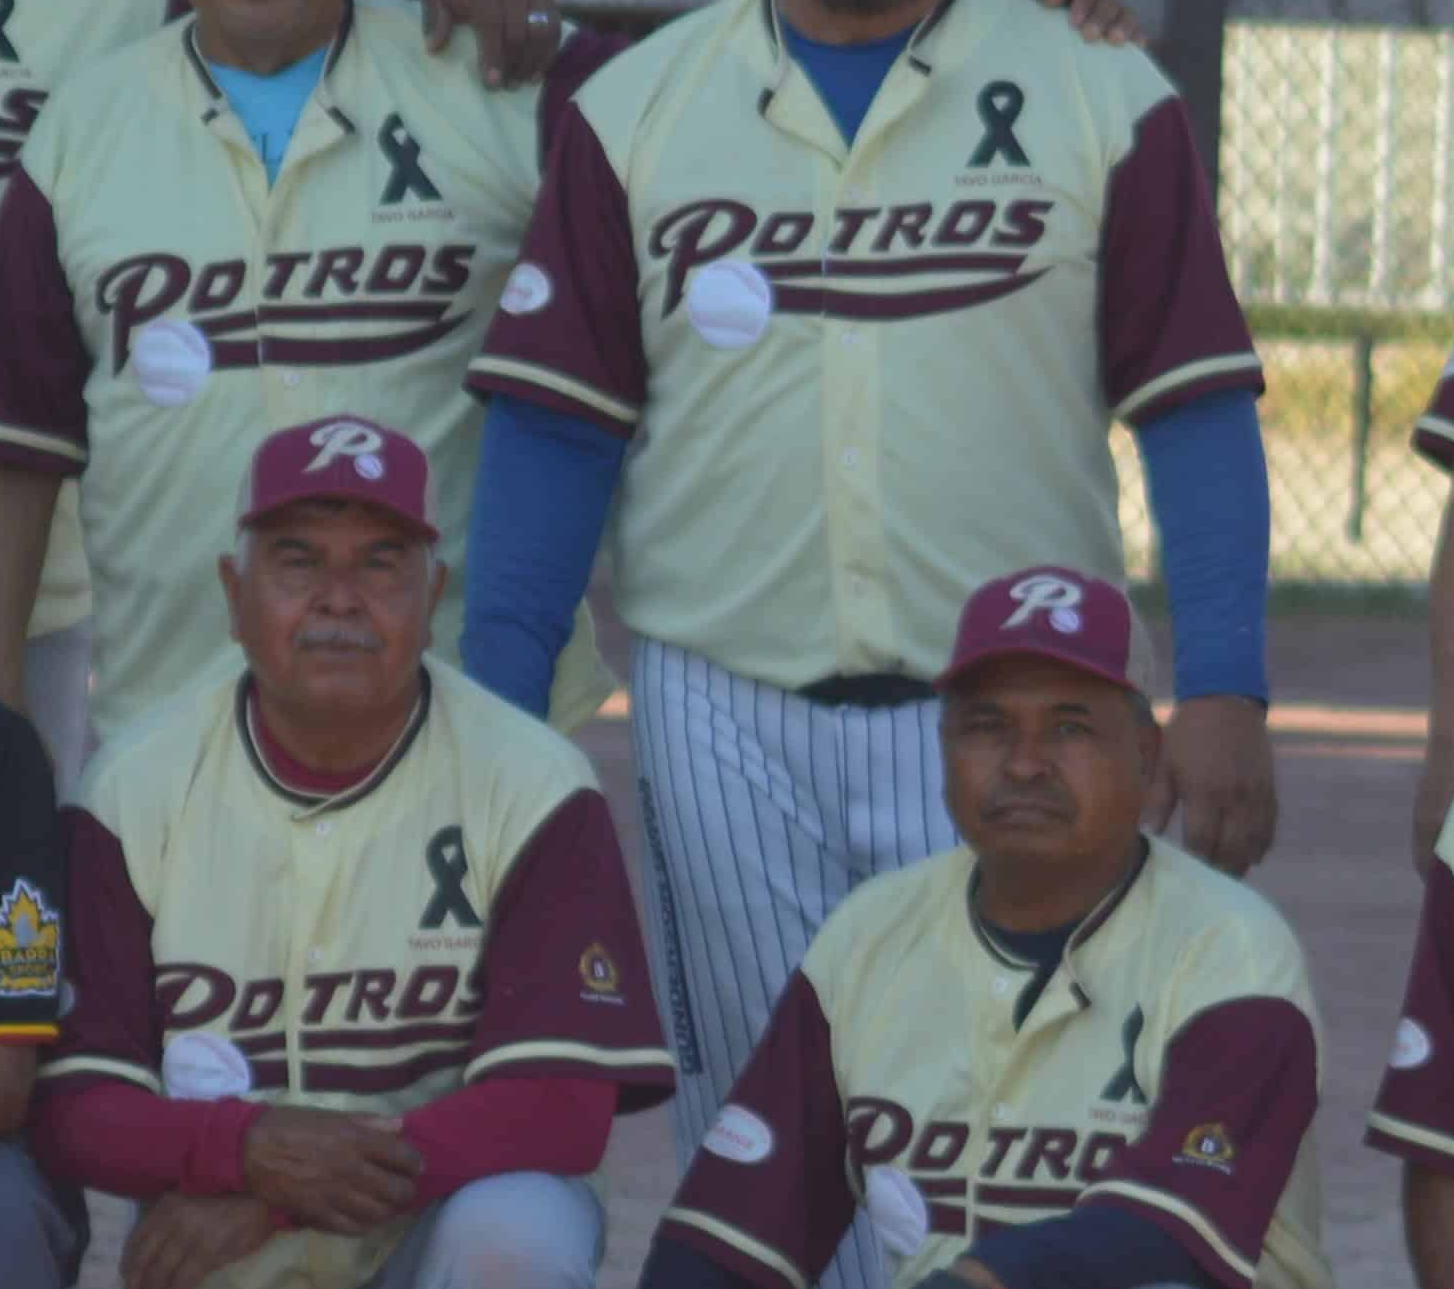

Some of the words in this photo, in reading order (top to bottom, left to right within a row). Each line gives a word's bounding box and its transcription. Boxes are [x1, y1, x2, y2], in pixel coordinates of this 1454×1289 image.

[95, 244, 478, 379] POTROS
[647, 197, 1057, 321] POTROS
[847, 1095, 1133, 1185] POTRO
